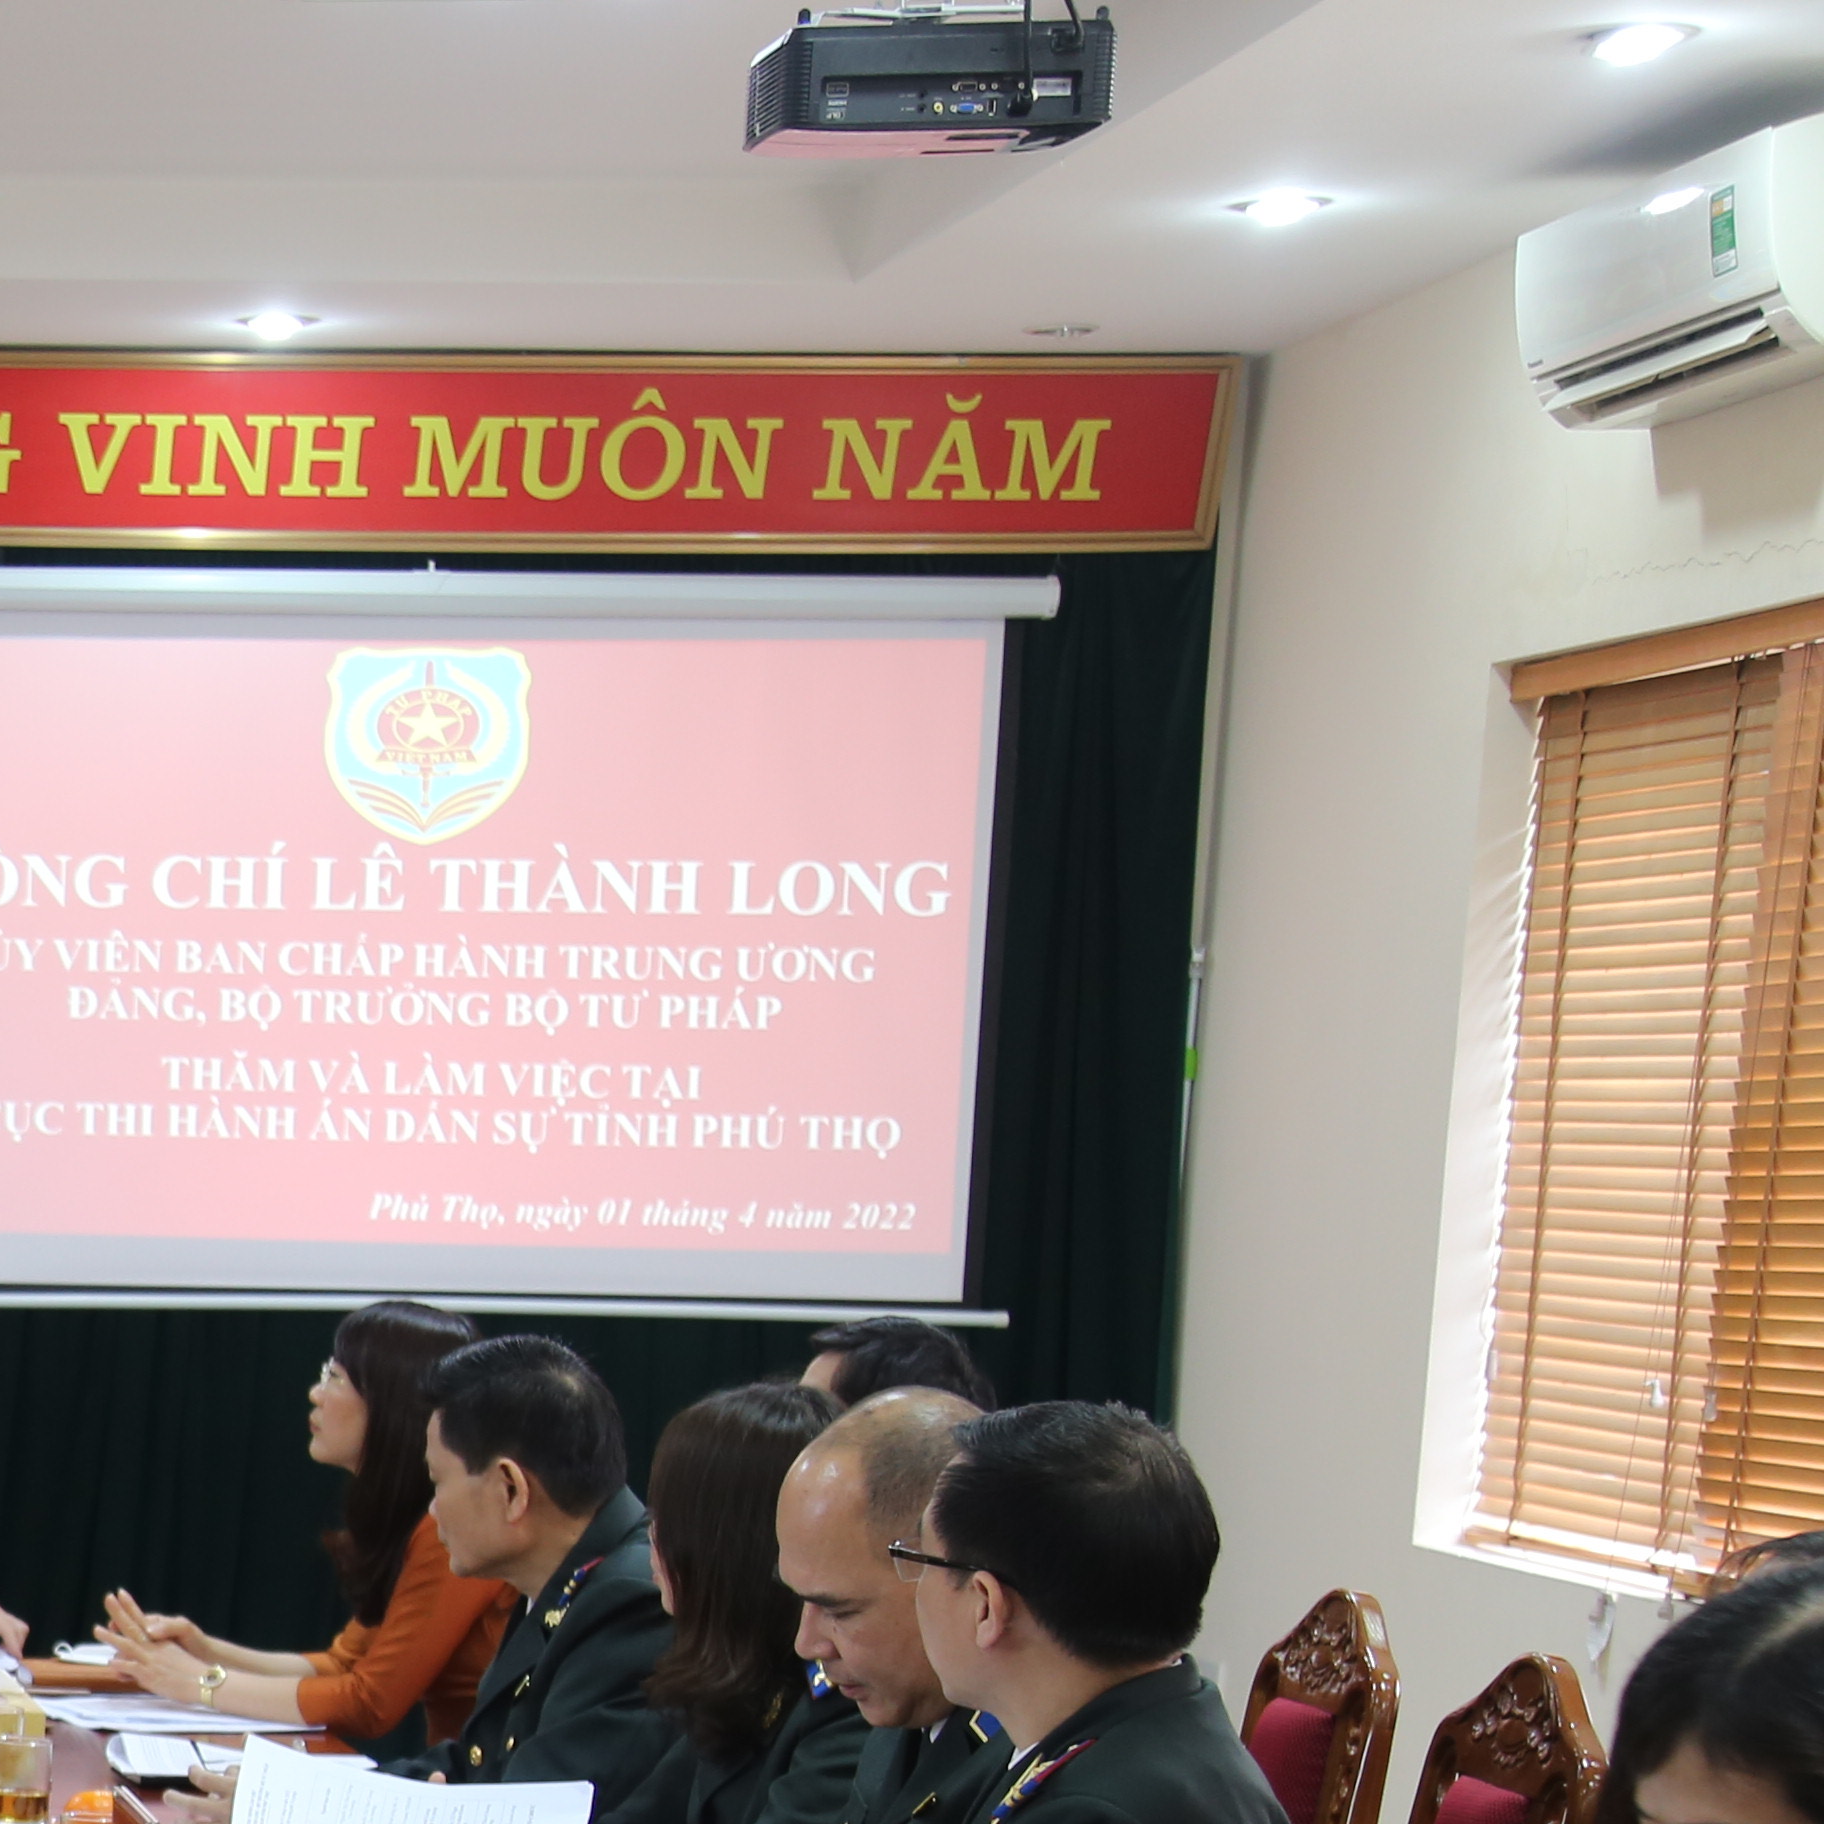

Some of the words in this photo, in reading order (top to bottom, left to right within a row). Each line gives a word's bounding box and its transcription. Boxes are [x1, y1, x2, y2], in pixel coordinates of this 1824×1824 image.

[57, 411, 376, 498] VINH
[402, 387, 785, 501] MUÔN
[812, 393, 1112, 501] NĂM
[152, 841, 289, 912] CHÍ
[312, 842, 406, 913] LÊ
[429, 841, 705, 916] THÀNH
[727, 860, 953, 918] LONG
[52, 930, 163, 974] VIÊN
[173, 940, 269, 976] BAN
[413, 933, 548, 980] HÀNH
[558, 944, 724, 983] TRUNG
[736, 942, 877, 984] ƯƠNG
[219, 983, 283, 1032] BỘ
[293, 980, 492, 1028] TRƯỞNG
[505, 988, 570, 1036] BỘ
[579, 988, 651, 1030] TƯ
[659, 985, 784, 1032] PHÁP
[160, 1049, 297, 1094] THĂM
[307, 1051, 371, 1096] VÀ
[383, 1051, 487, 1099] LÀM
[498, 1060, 613, 1107] VIỆC
[621, 1063, 704, 1110] TẠI
[75, 1102, 155, 1137] THI
[167, 1095, 298, 1140] HÀNH
[308, 1098, 374, 1143] ÁN
[491, 1106, 558, 1155] SỰ
[692, 1105, 787, 1152] PHÚ
[799, 1114, 903, 1160] THỌ
[440, 1194, 507, 1231] Thọ,
[515, 1199, 590, 1234] ngày
[596, 1199, 632, 1228] 01
[641, 1199, 729, 1236] tháng
[738, 1200, 758, 1229] 4
[765, 1201, 834, 1231] năm
[841, 1202, 918, 1232] 2022
